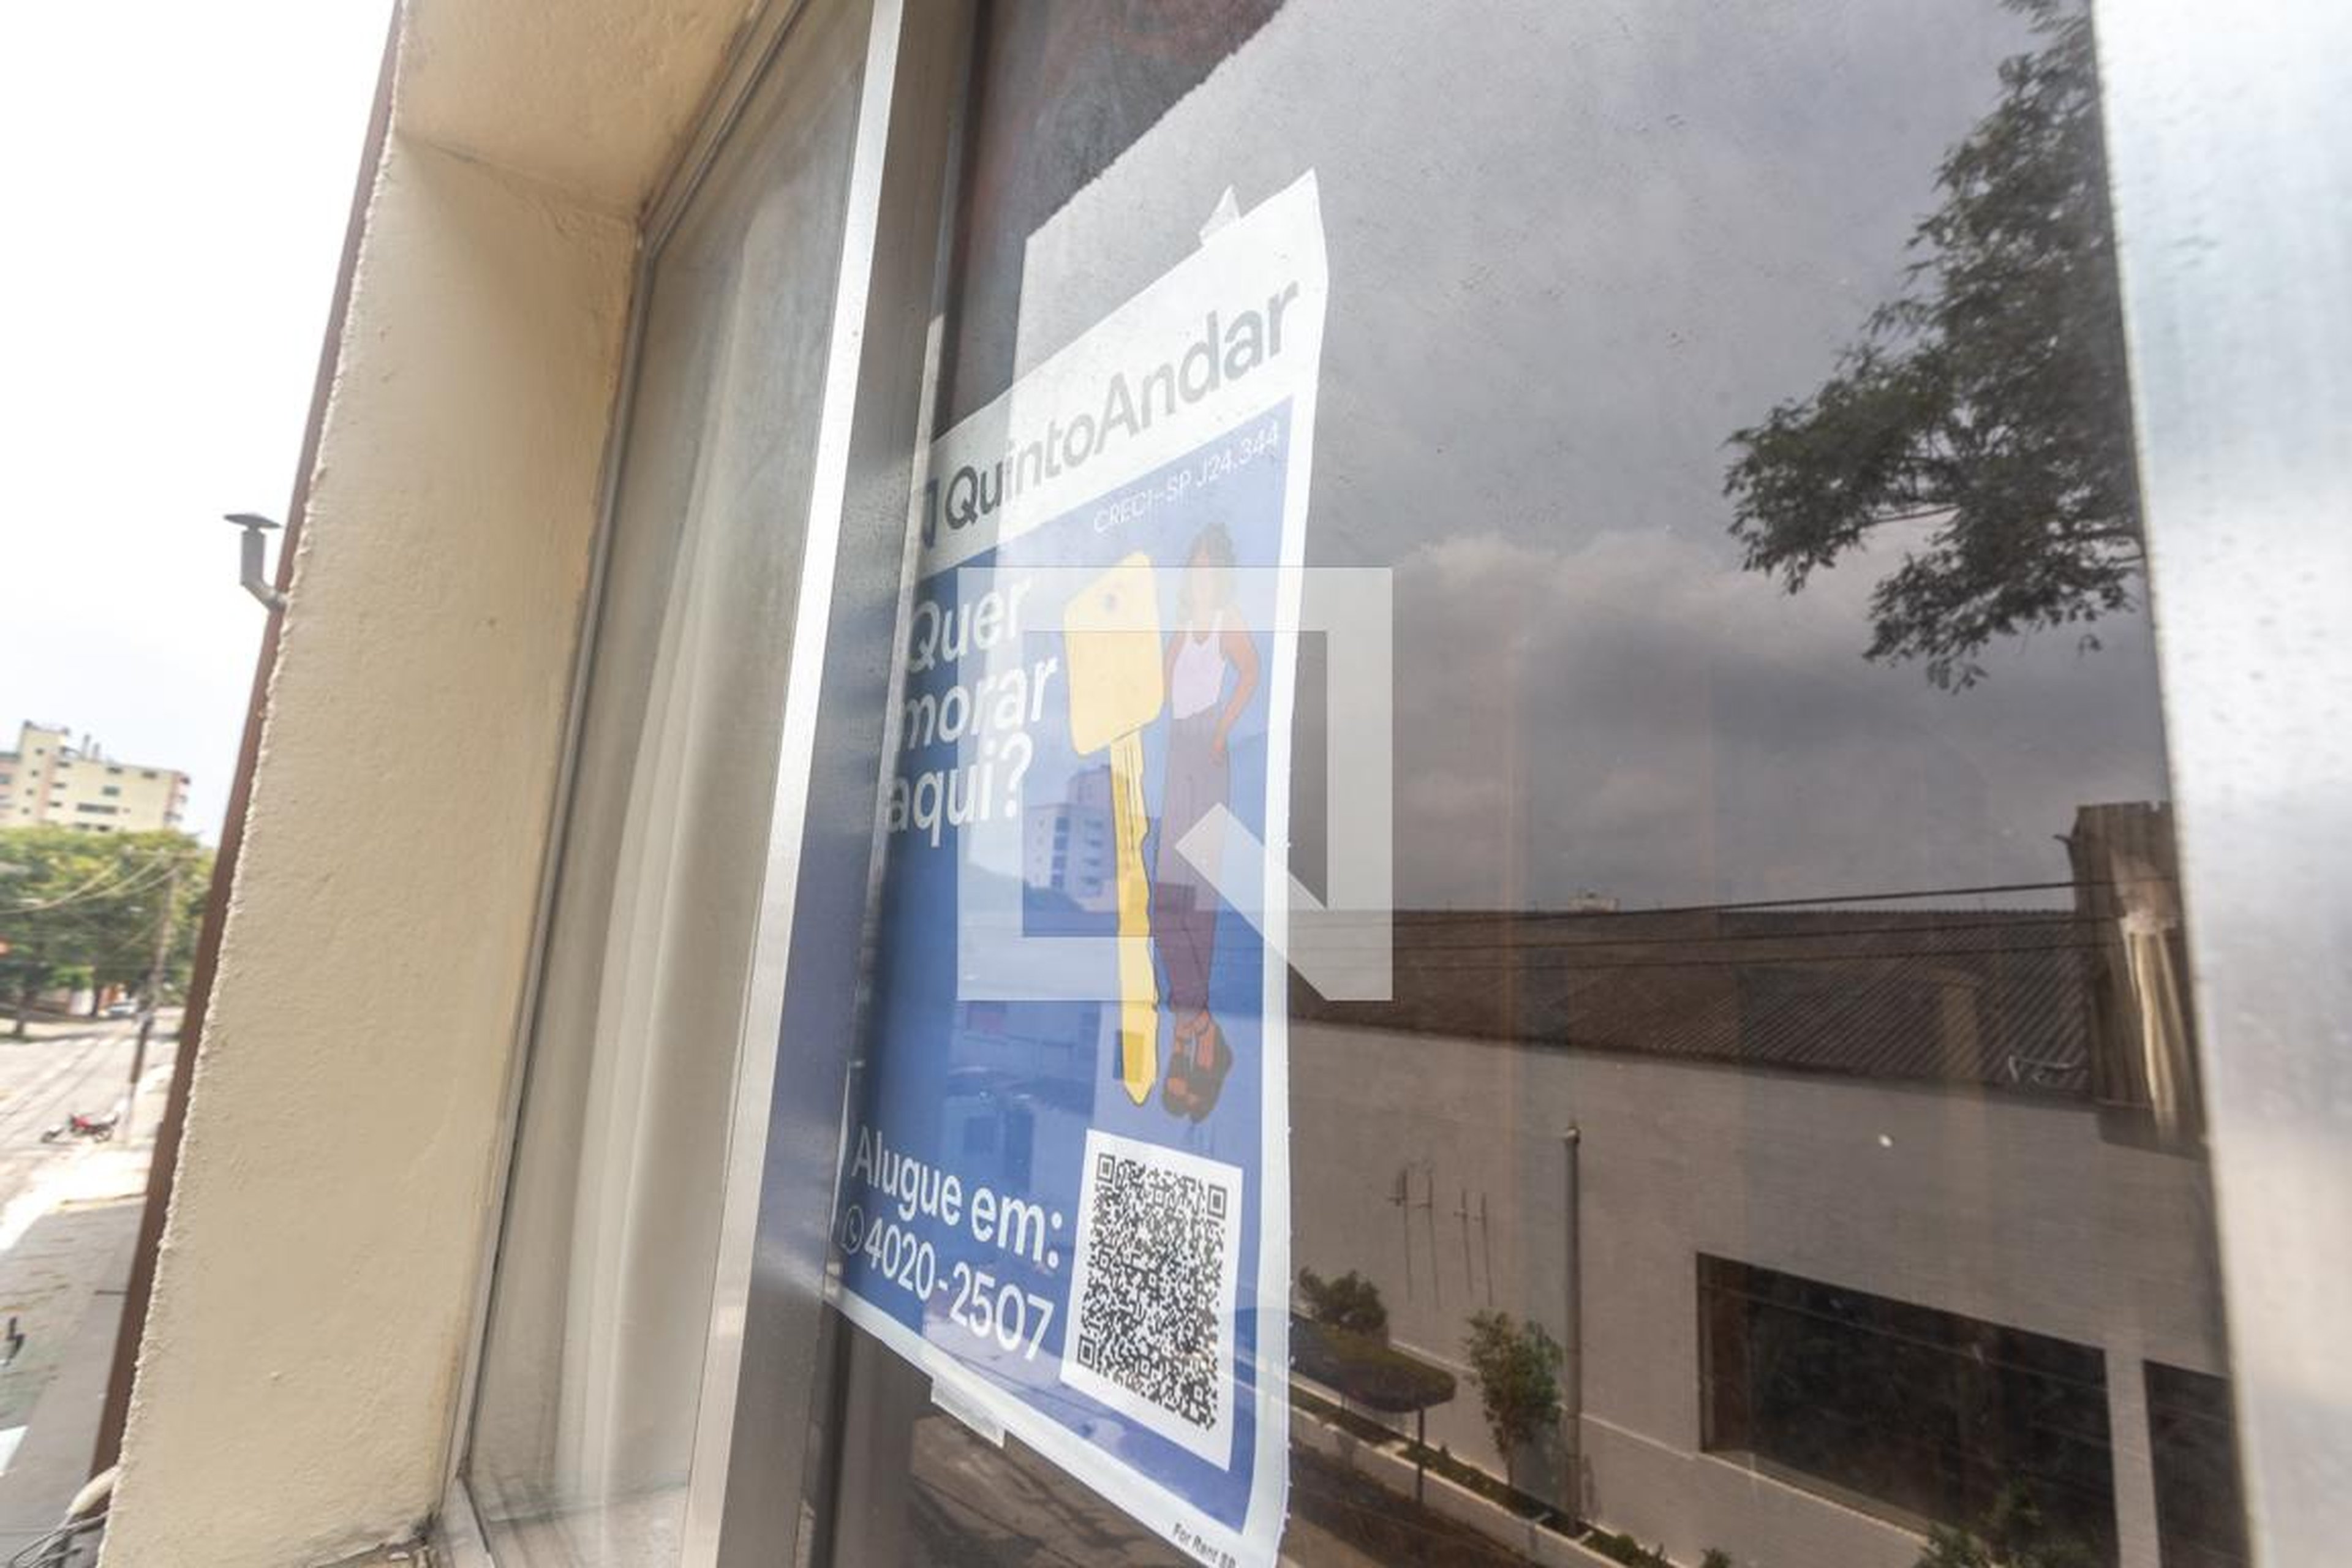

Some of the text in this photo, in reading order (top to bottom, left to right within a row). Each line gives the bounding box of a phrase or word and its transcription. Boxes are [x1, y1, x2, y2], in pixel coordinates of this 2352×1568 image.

[944, 281, 1298, 530] QuintoAndar
[1093, 420, 1278, 533] CRECI-SP J24.344
[910, 578, 1032, 673] Quer
[889, 732, 1033, 848] aqui?
[851, 1125, 1063, 1268] Alugue em:
[864, 1217, 1055, 1362] 4020-2507
[1173, 1522, 1191, 1544] For
[1193, 1535, 1219, 1564] Rent
